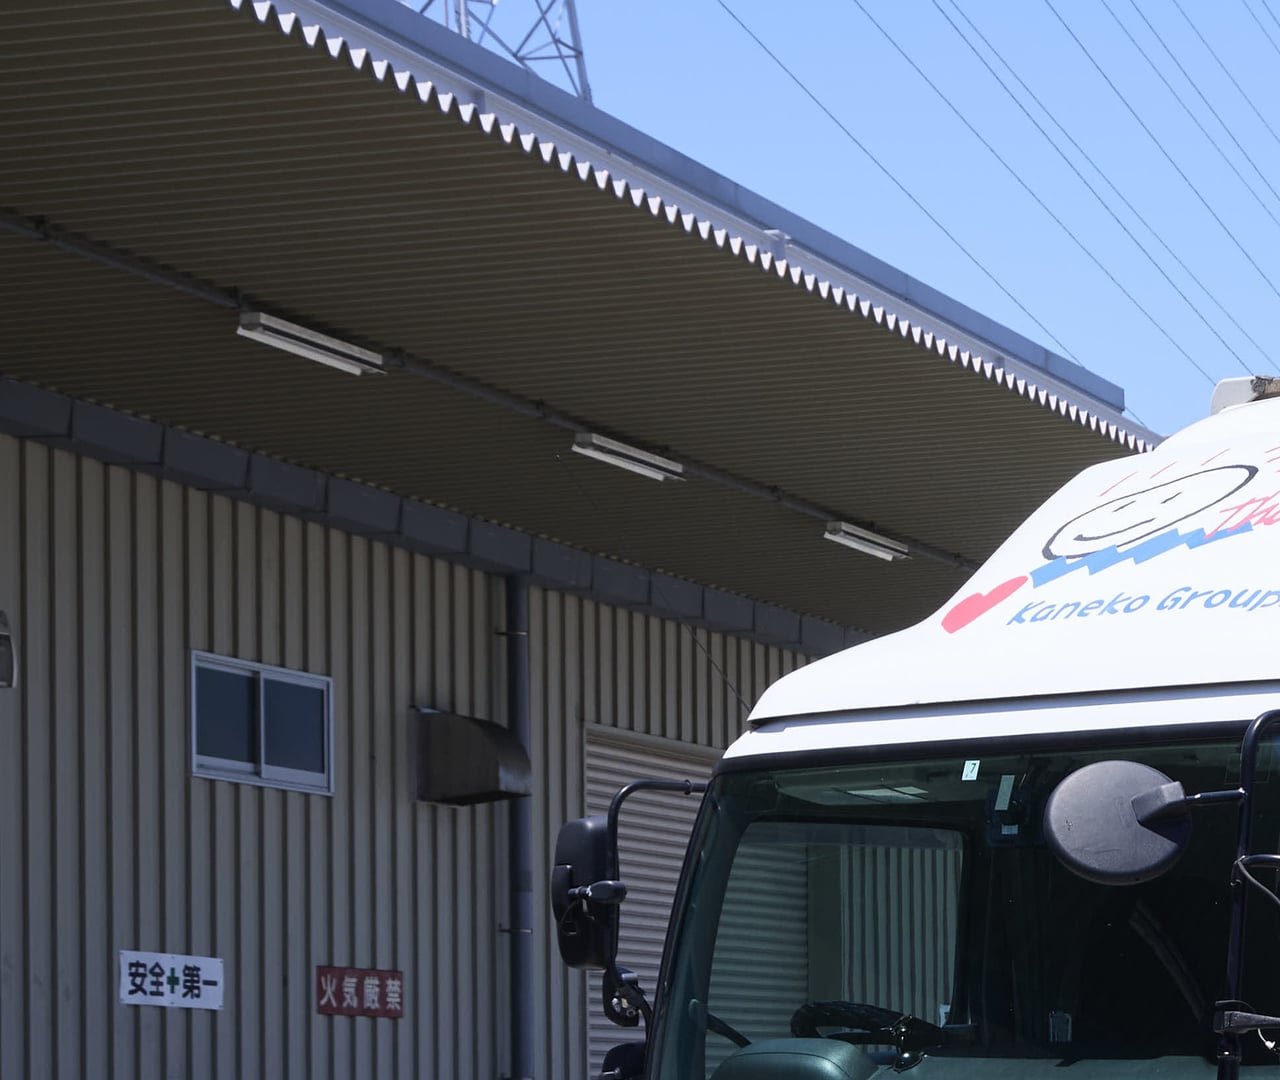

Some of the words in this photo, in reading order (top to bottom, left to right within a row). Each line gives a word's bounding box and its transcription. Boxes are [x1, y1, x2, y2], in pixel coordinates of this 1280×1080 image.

[1006, 591, 1151, 626] Kaneko
[320, 973, 402, 1011] 火気厳禁
